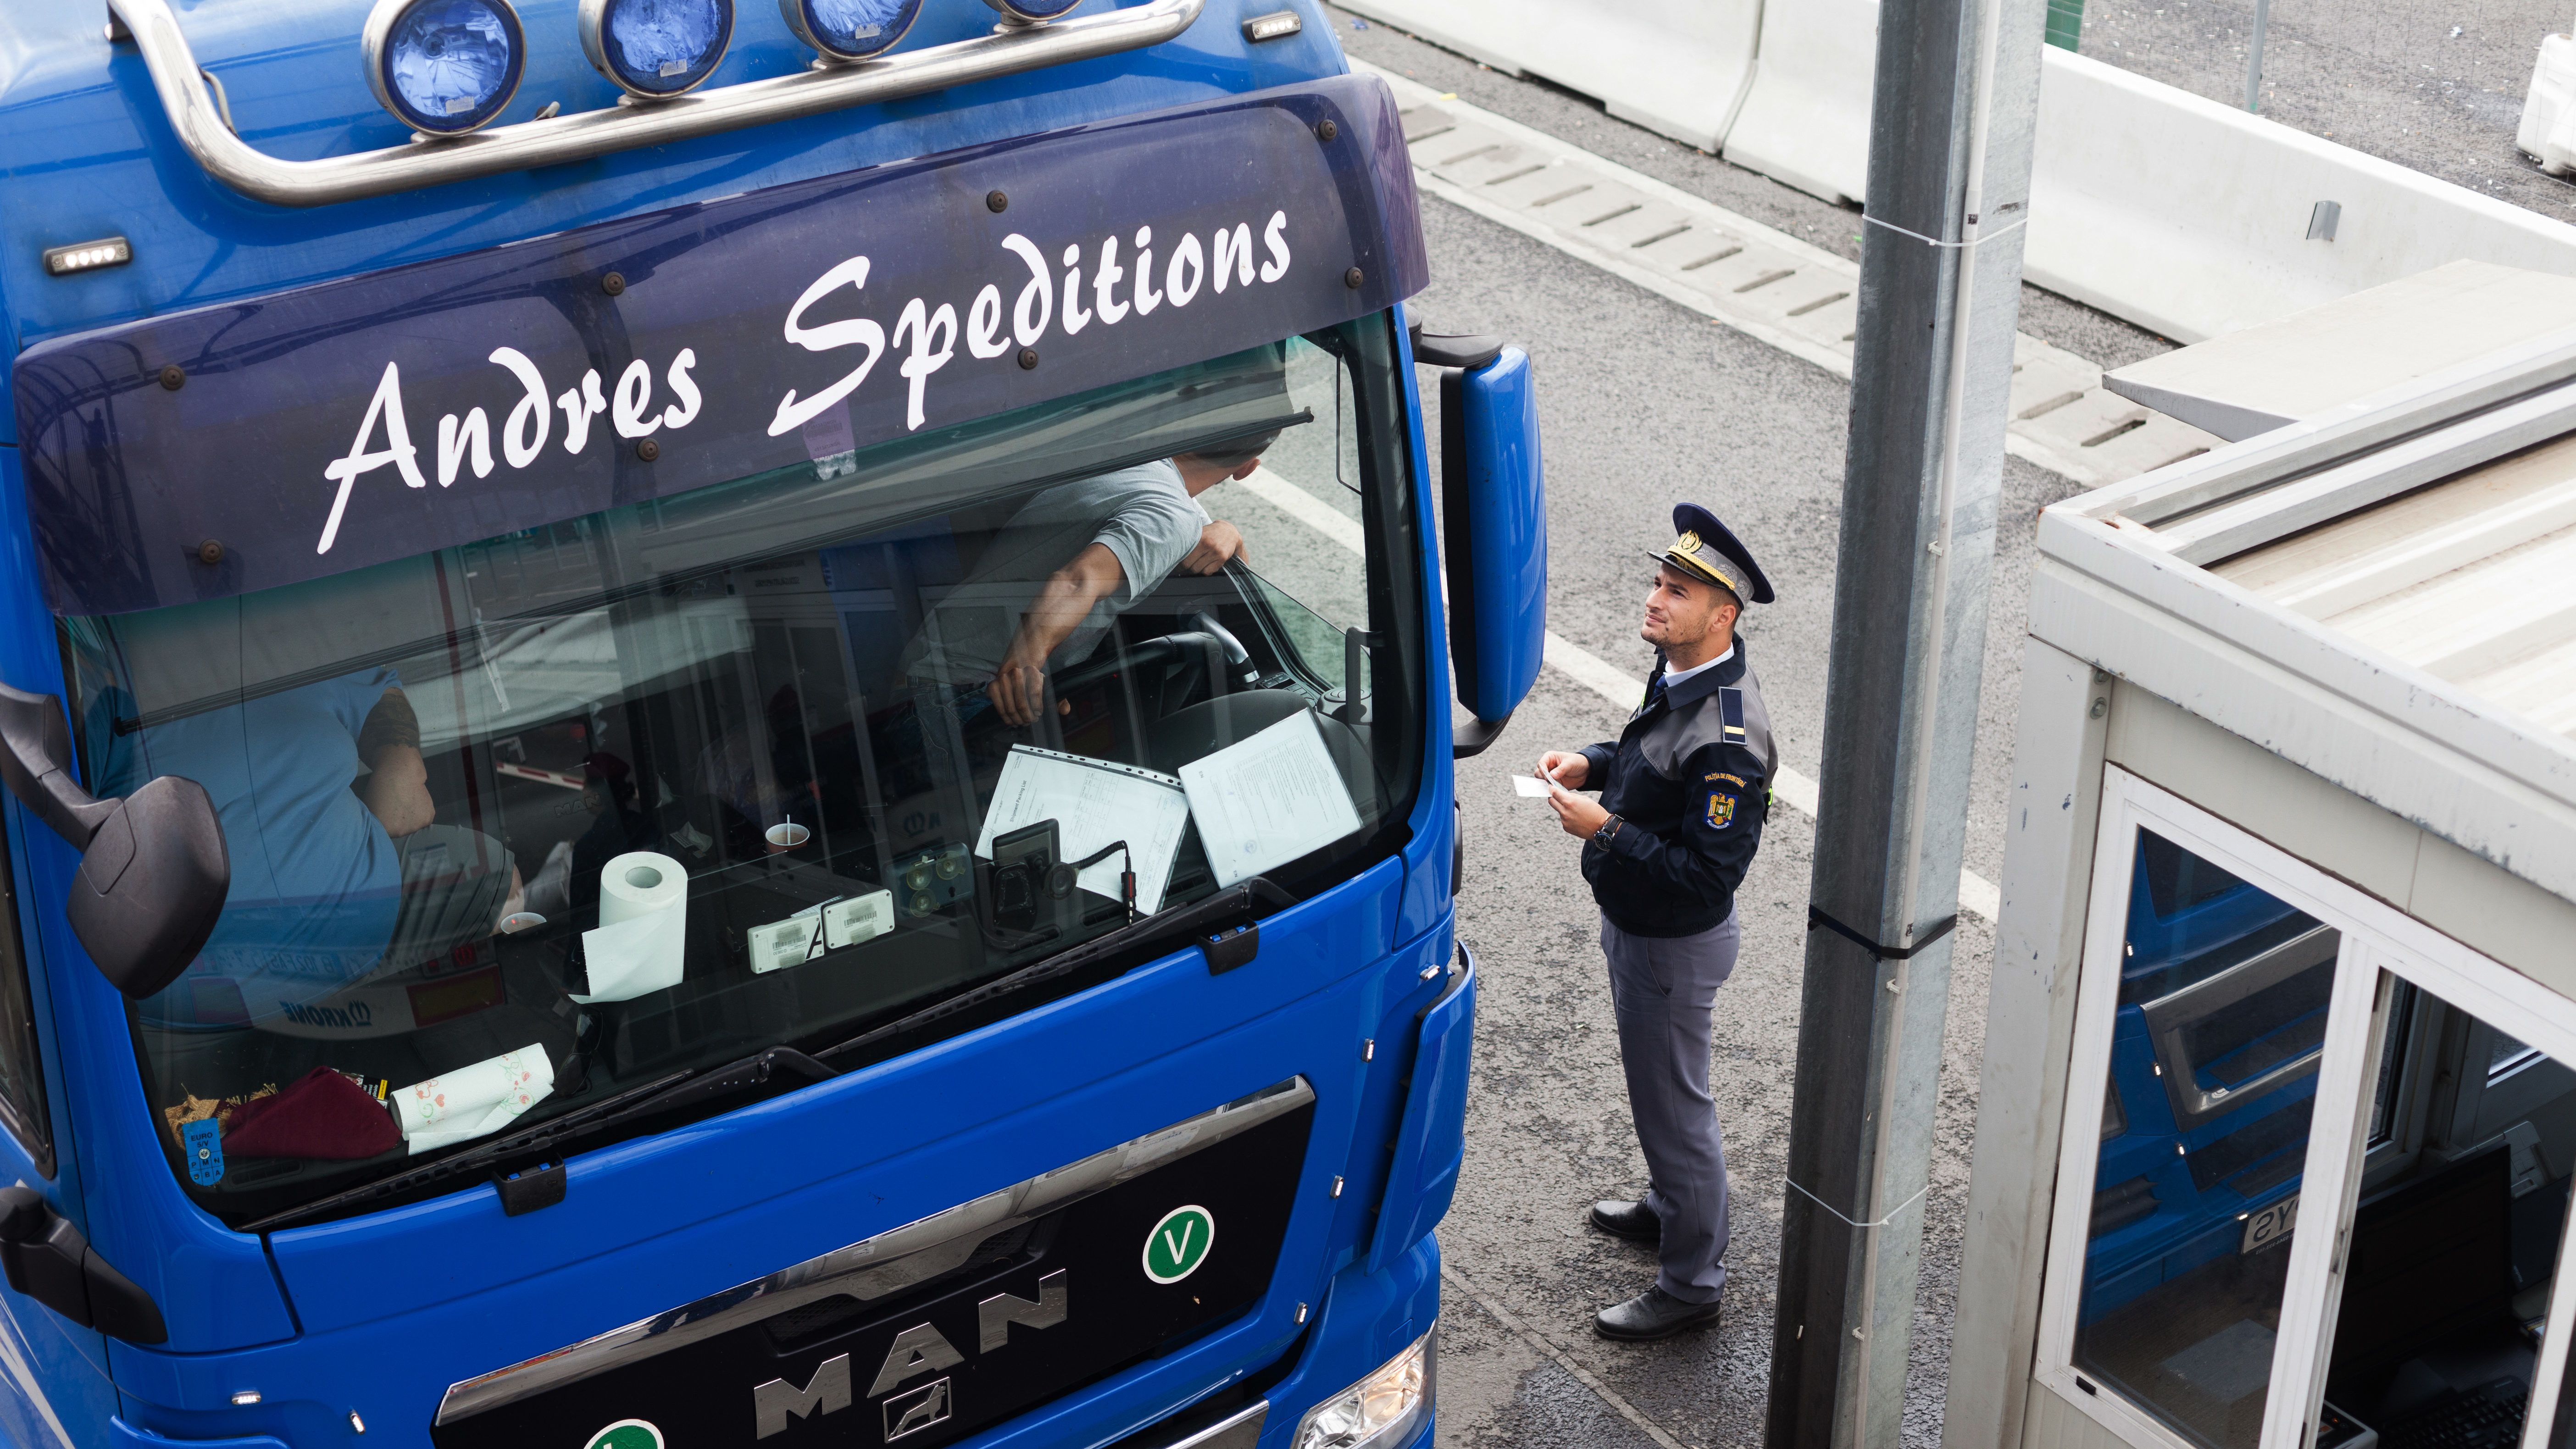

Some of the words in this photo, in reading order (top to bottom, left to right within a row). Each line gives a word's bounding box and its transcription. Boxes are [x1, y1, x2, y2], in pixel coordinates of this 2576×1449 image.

[317, 347, 702, 554] Andres
[768, 210, 1290, 436] Speditions
[554, 793, 602, 818] MAN
[1010, 803, 1019, 822] Shipment
[1016, 788, 1025, 803] Packing
[191, 1132, 213, 1141] EURO
[1164, 1220, 1194, 1265] V
[754, 1268, 1067, 1440] MAN
